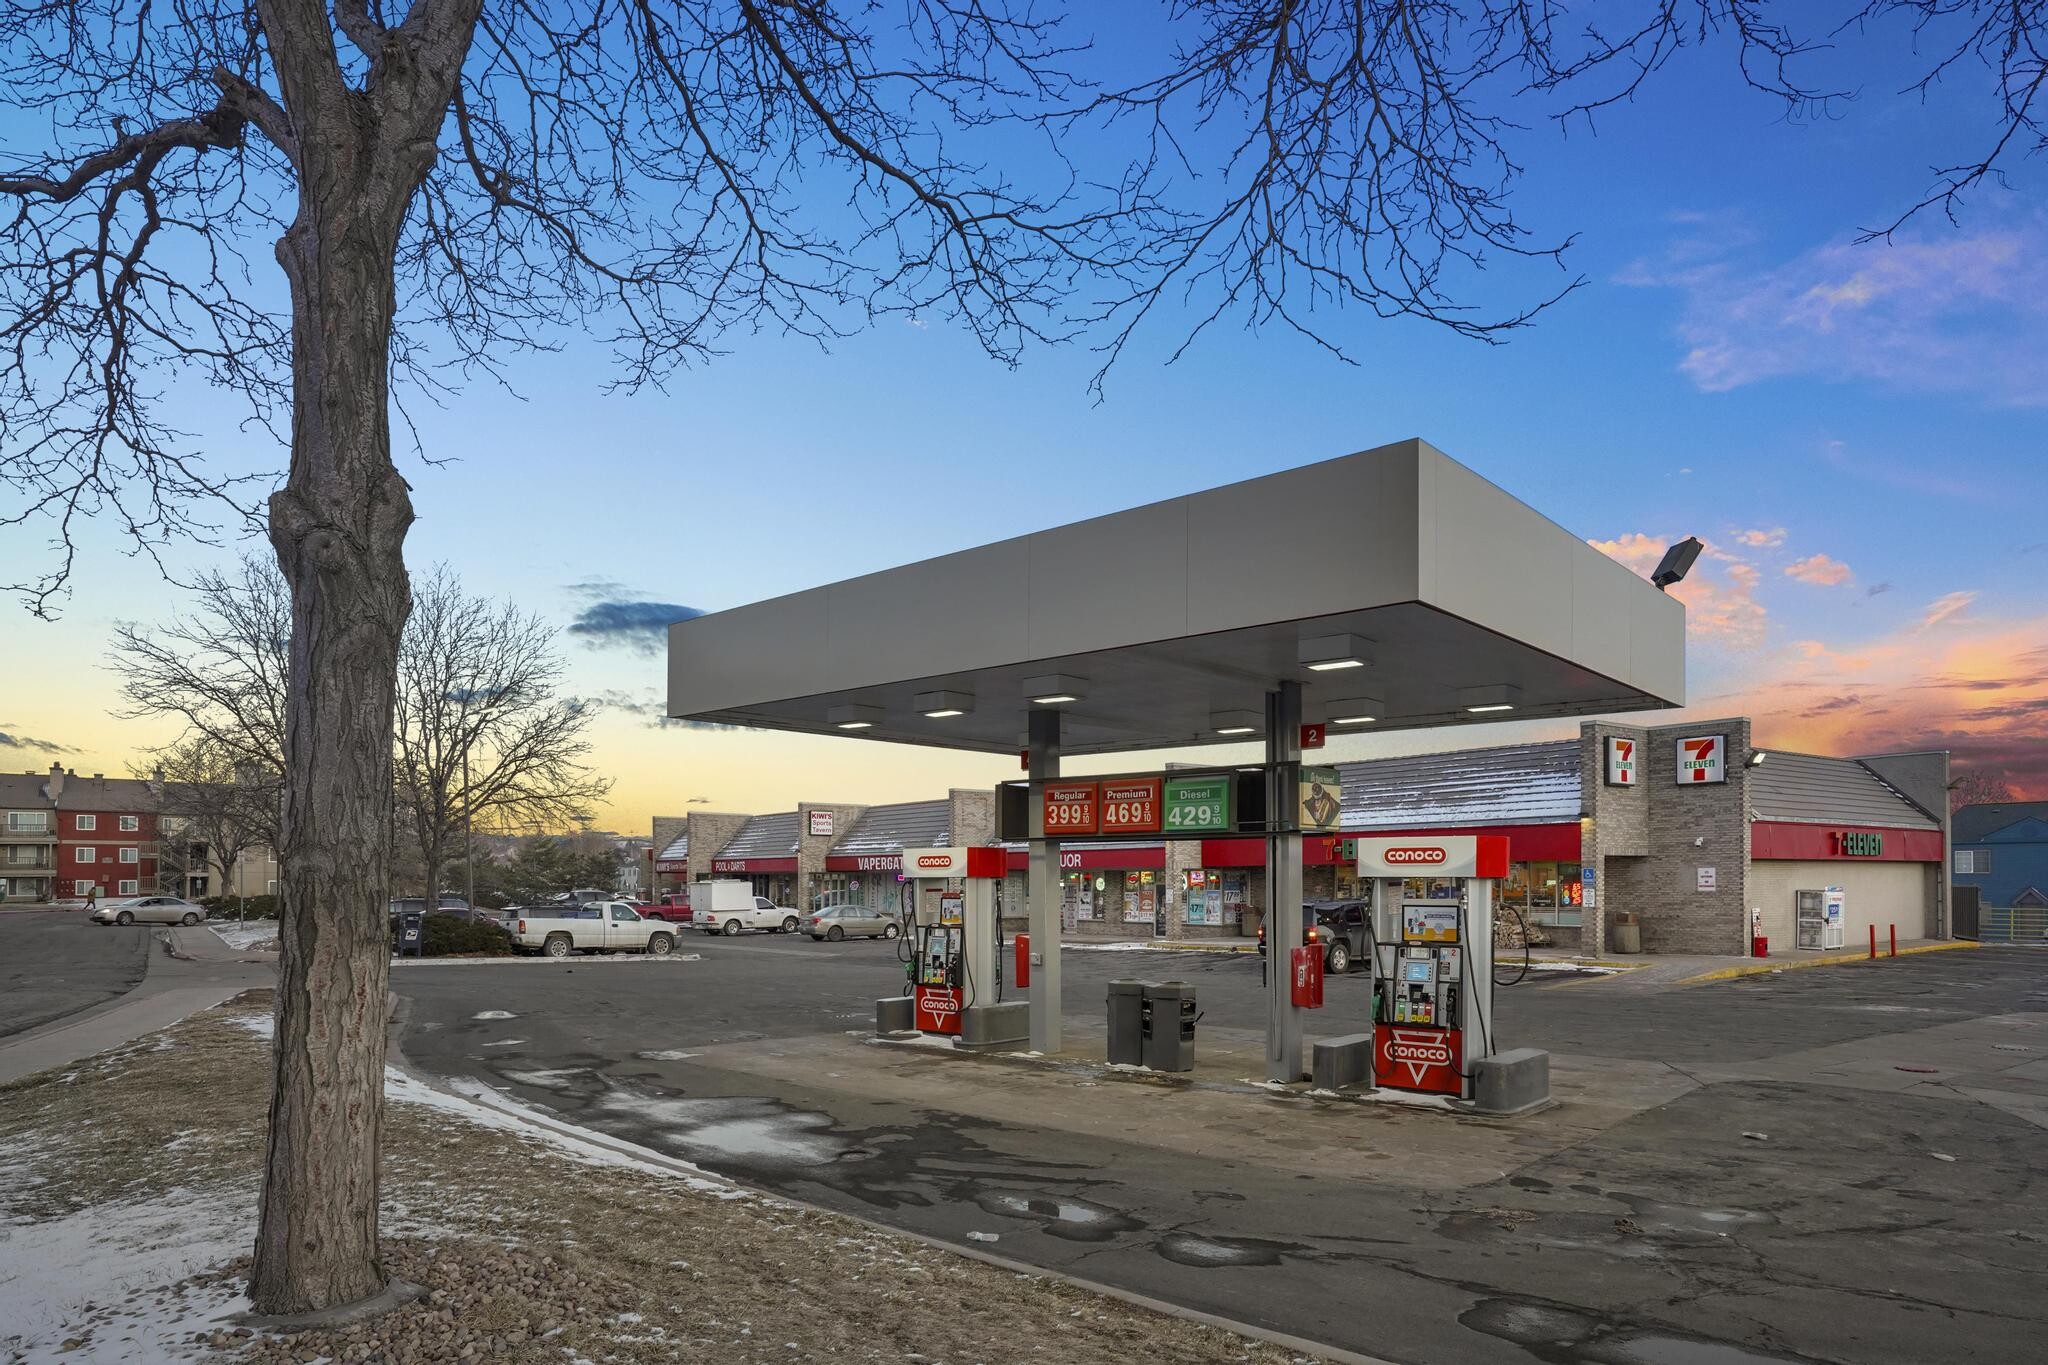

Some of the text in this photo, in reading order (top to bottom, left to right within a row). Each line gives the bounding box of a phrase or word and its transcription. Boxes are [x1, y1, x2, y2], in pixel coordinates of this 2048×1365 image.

[1309, 729, 1317, 742] 2
[1054, 791, 1086, 801] Regular
[1107, 789, 1147, 799] Premium
[1180, 788, 1210, 800] Diesel
[1048, 804, 1081, 824] 399
[1106, 802, 1142, 823] 469
[1168, 805, 1211, 825] 429
[715, 861, 728, 871] POOL
[730, 861, 746, 871] DARTS
